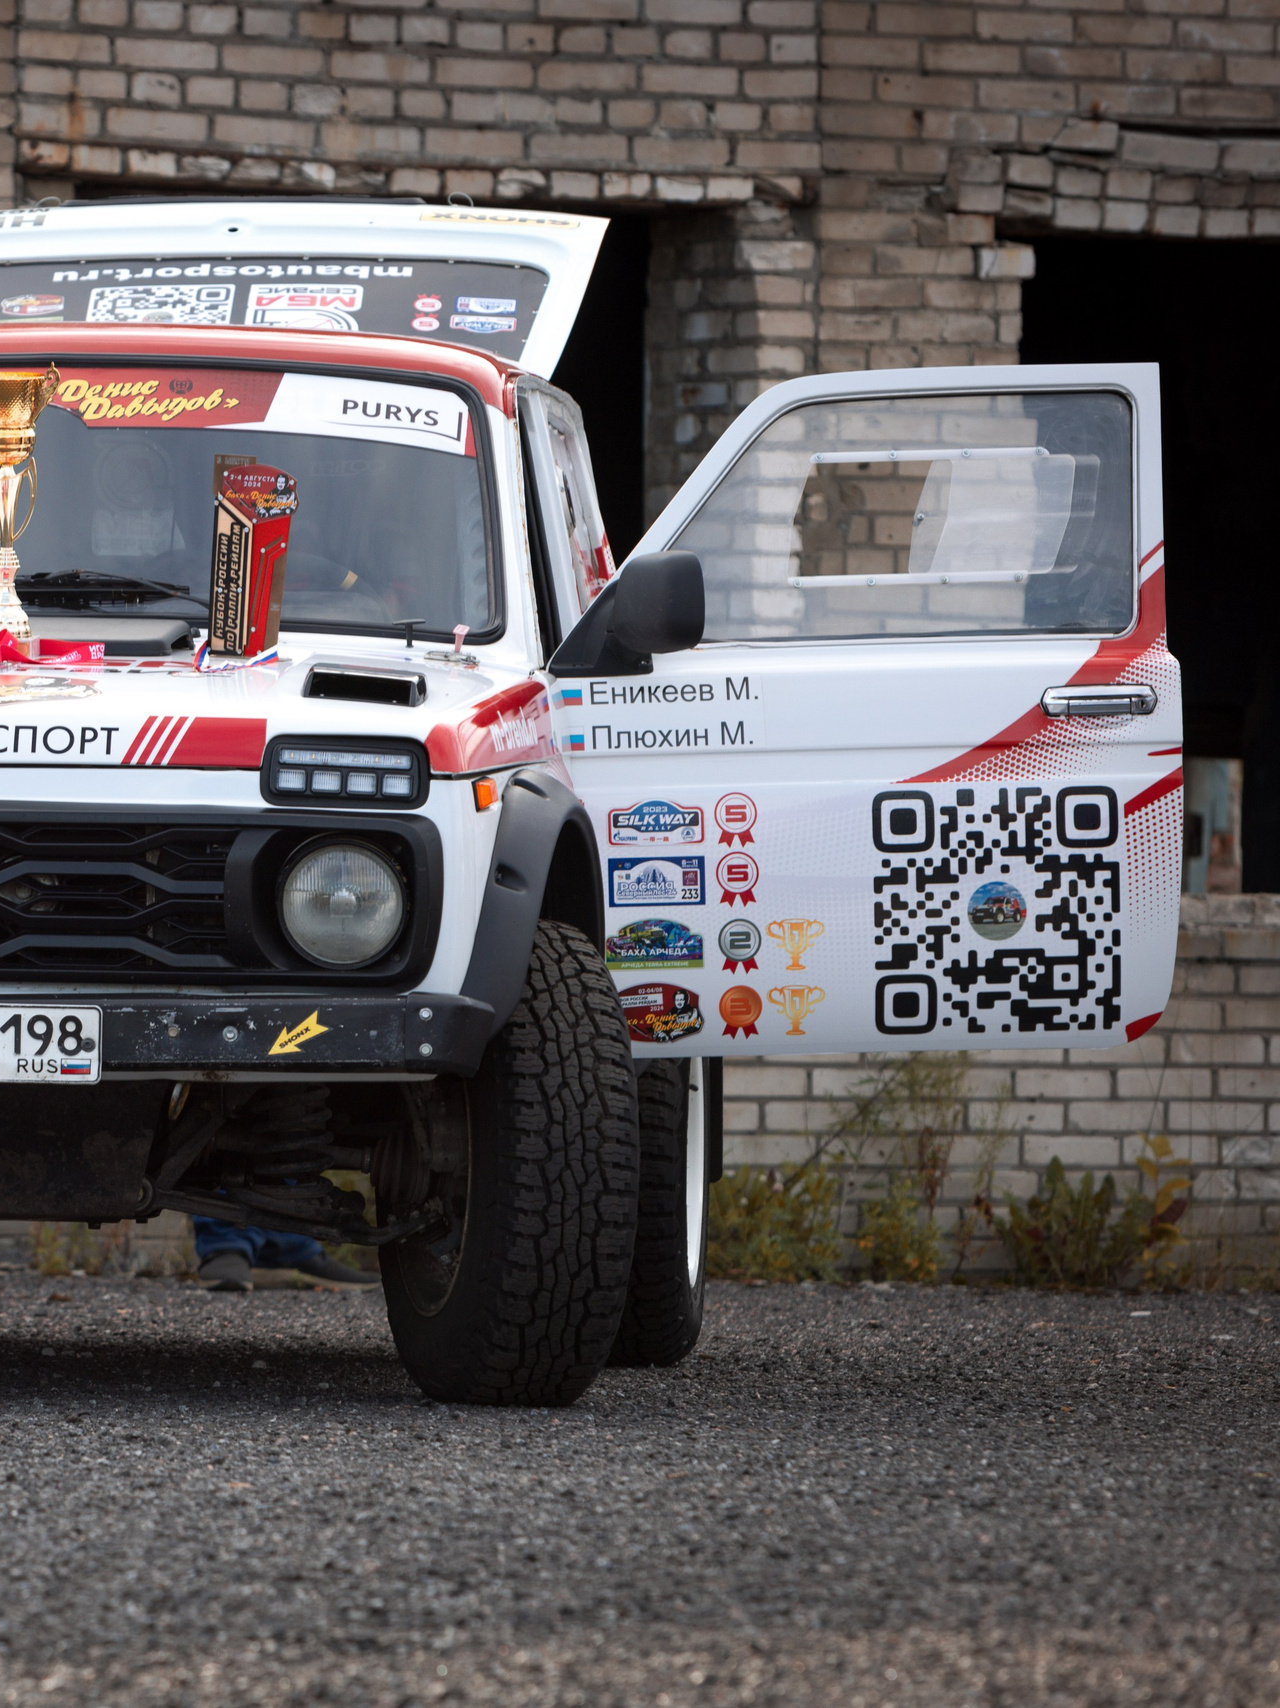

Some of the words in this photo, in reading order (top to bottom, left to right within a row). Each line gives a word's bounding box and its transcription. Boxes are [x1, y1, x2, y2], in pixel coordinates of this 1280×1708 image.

[52, 263, 414, 283] mbautosport.ru
[258, 286, 357, 296] СЕРВИС
[58, 378, 160, 403] Денис
[341, 398, 440, 427] PURYS
[218, 535, 229, 588] РОССИИ
[228, 524, 241, 629] РАЛЛИ-РЕЙДАМ
[215, 590, 227, 637] КУБОК
[226, 633, 235, 650] ПО
[589, 680, 715, 706] Еникеев
[725, 676, 759, 701] М.
[591, 725, 710, 750] Плюхин
[720, 721, 754, 746] М.
[617, 814, 657, 826] SILK
[659, 813, 695, 825] WAY
[725, 804, 747, 823] 5
[727, 864, 749, 882] 5
[618, 880, 675, 891] РОССИЯ
[681, 888, 699, 900] 233
[729, 931, 751, 950] 2
[621, 948, 647, 956] БАХА
[649, 947, 688, 956] АРЧЕДА
[0, 1013, 84, 1057] 198
[279, 1026, 311, 1049] SHONX
[17, 1058, 59, 1075] RUS
